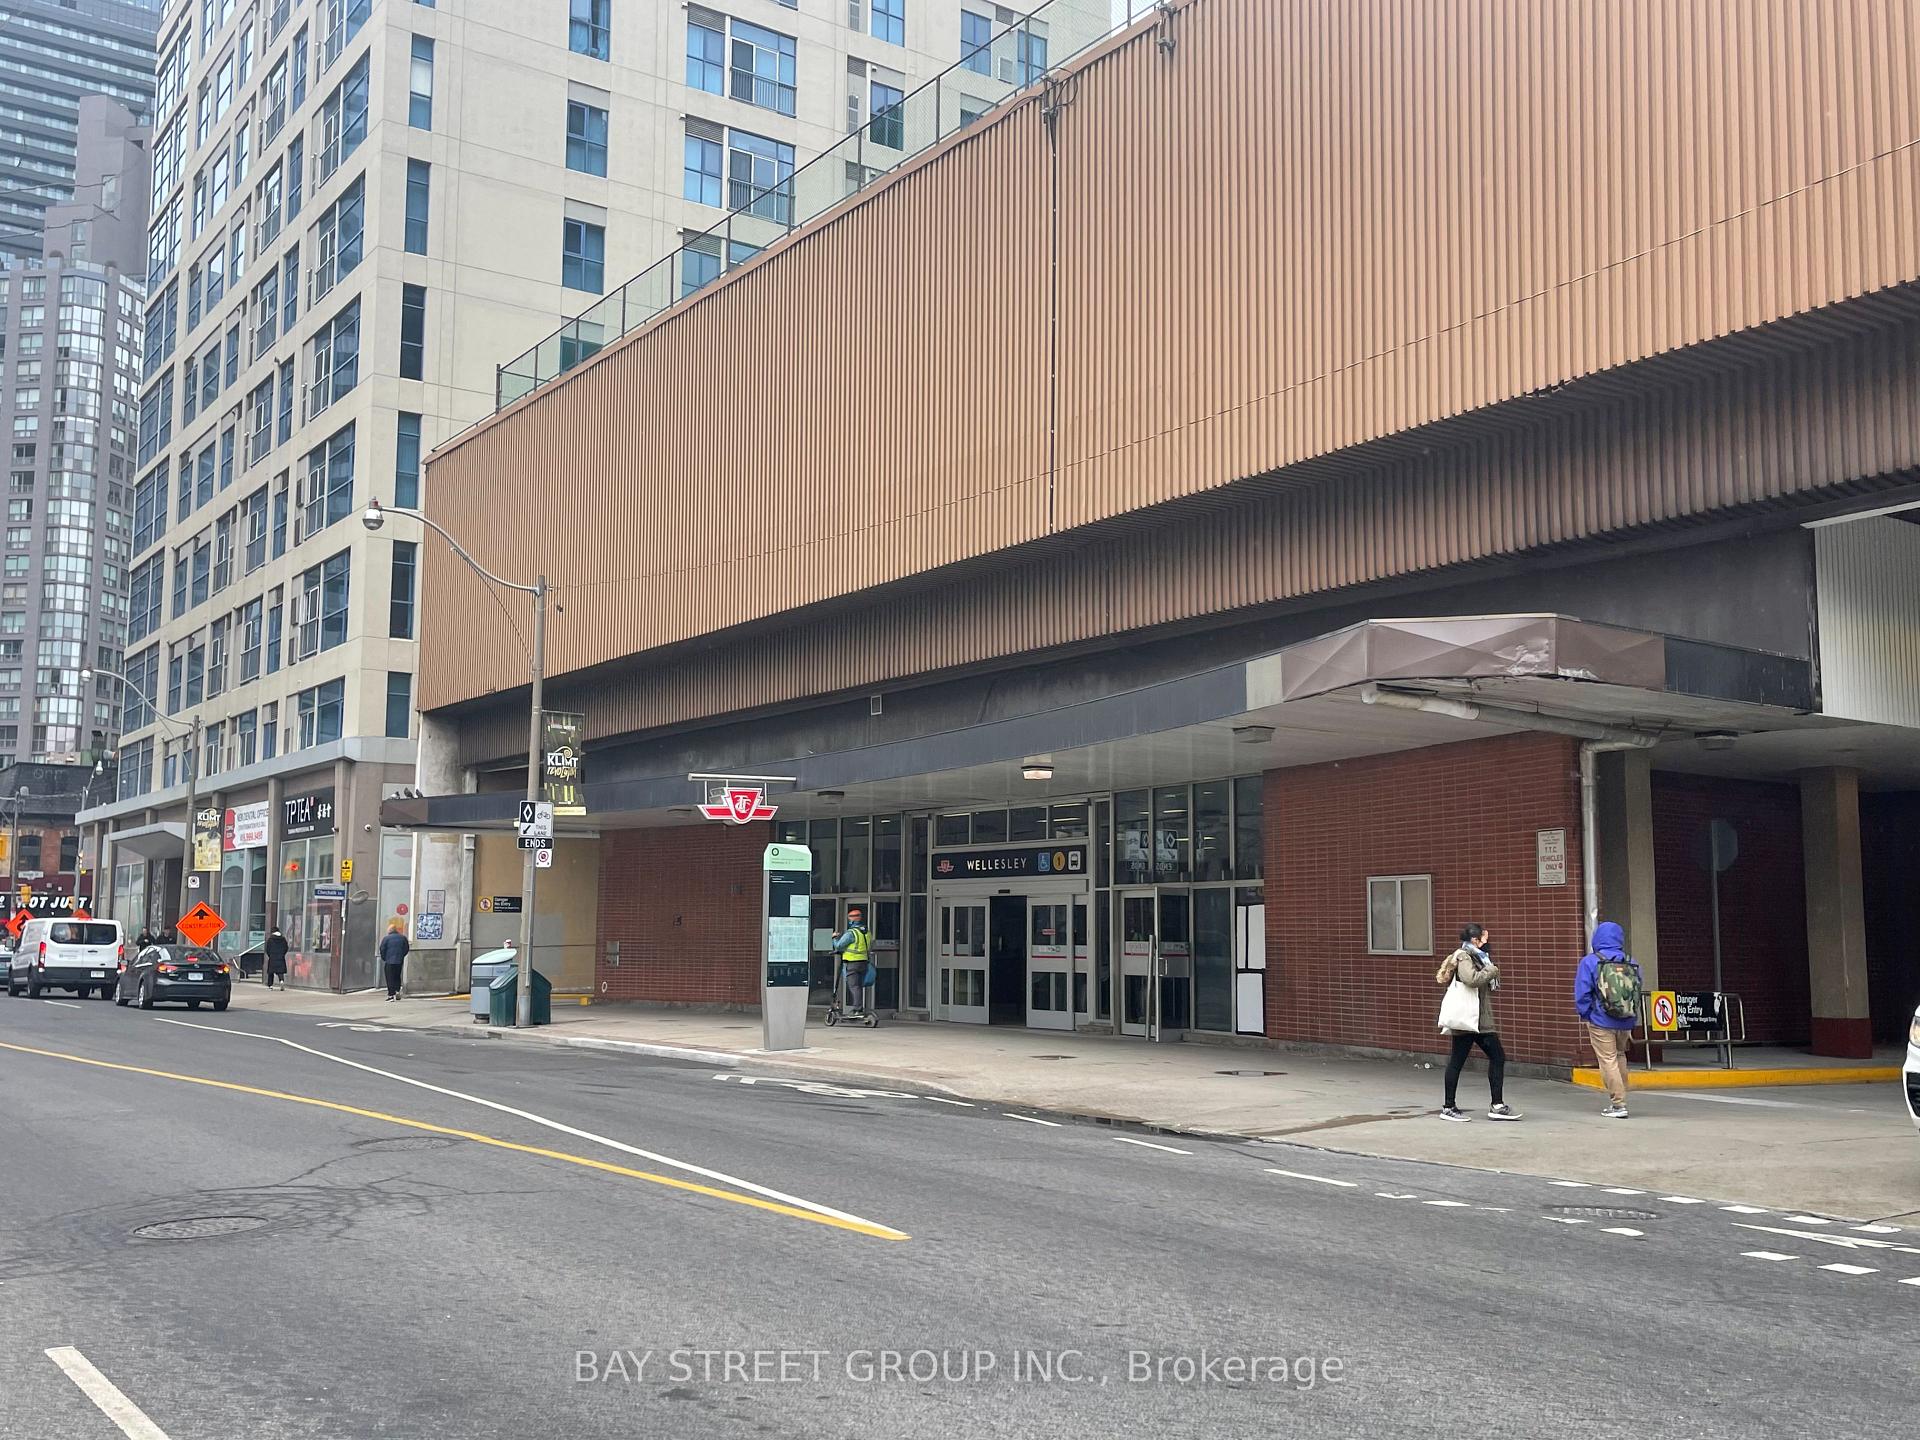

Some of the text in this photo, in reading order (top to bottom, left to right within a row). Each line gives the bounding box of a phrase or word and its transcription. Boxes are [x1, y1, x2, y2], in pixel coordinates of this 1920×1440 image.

[547, 746, 578, 767] KLIMT
[525, 839, 546, 848] ENDS
[966, 857, 1027, 871] WELLESLEY
[1677, 995, 1698, 1005] Danger
[1687, 1006, 1703, 1015] Entry
